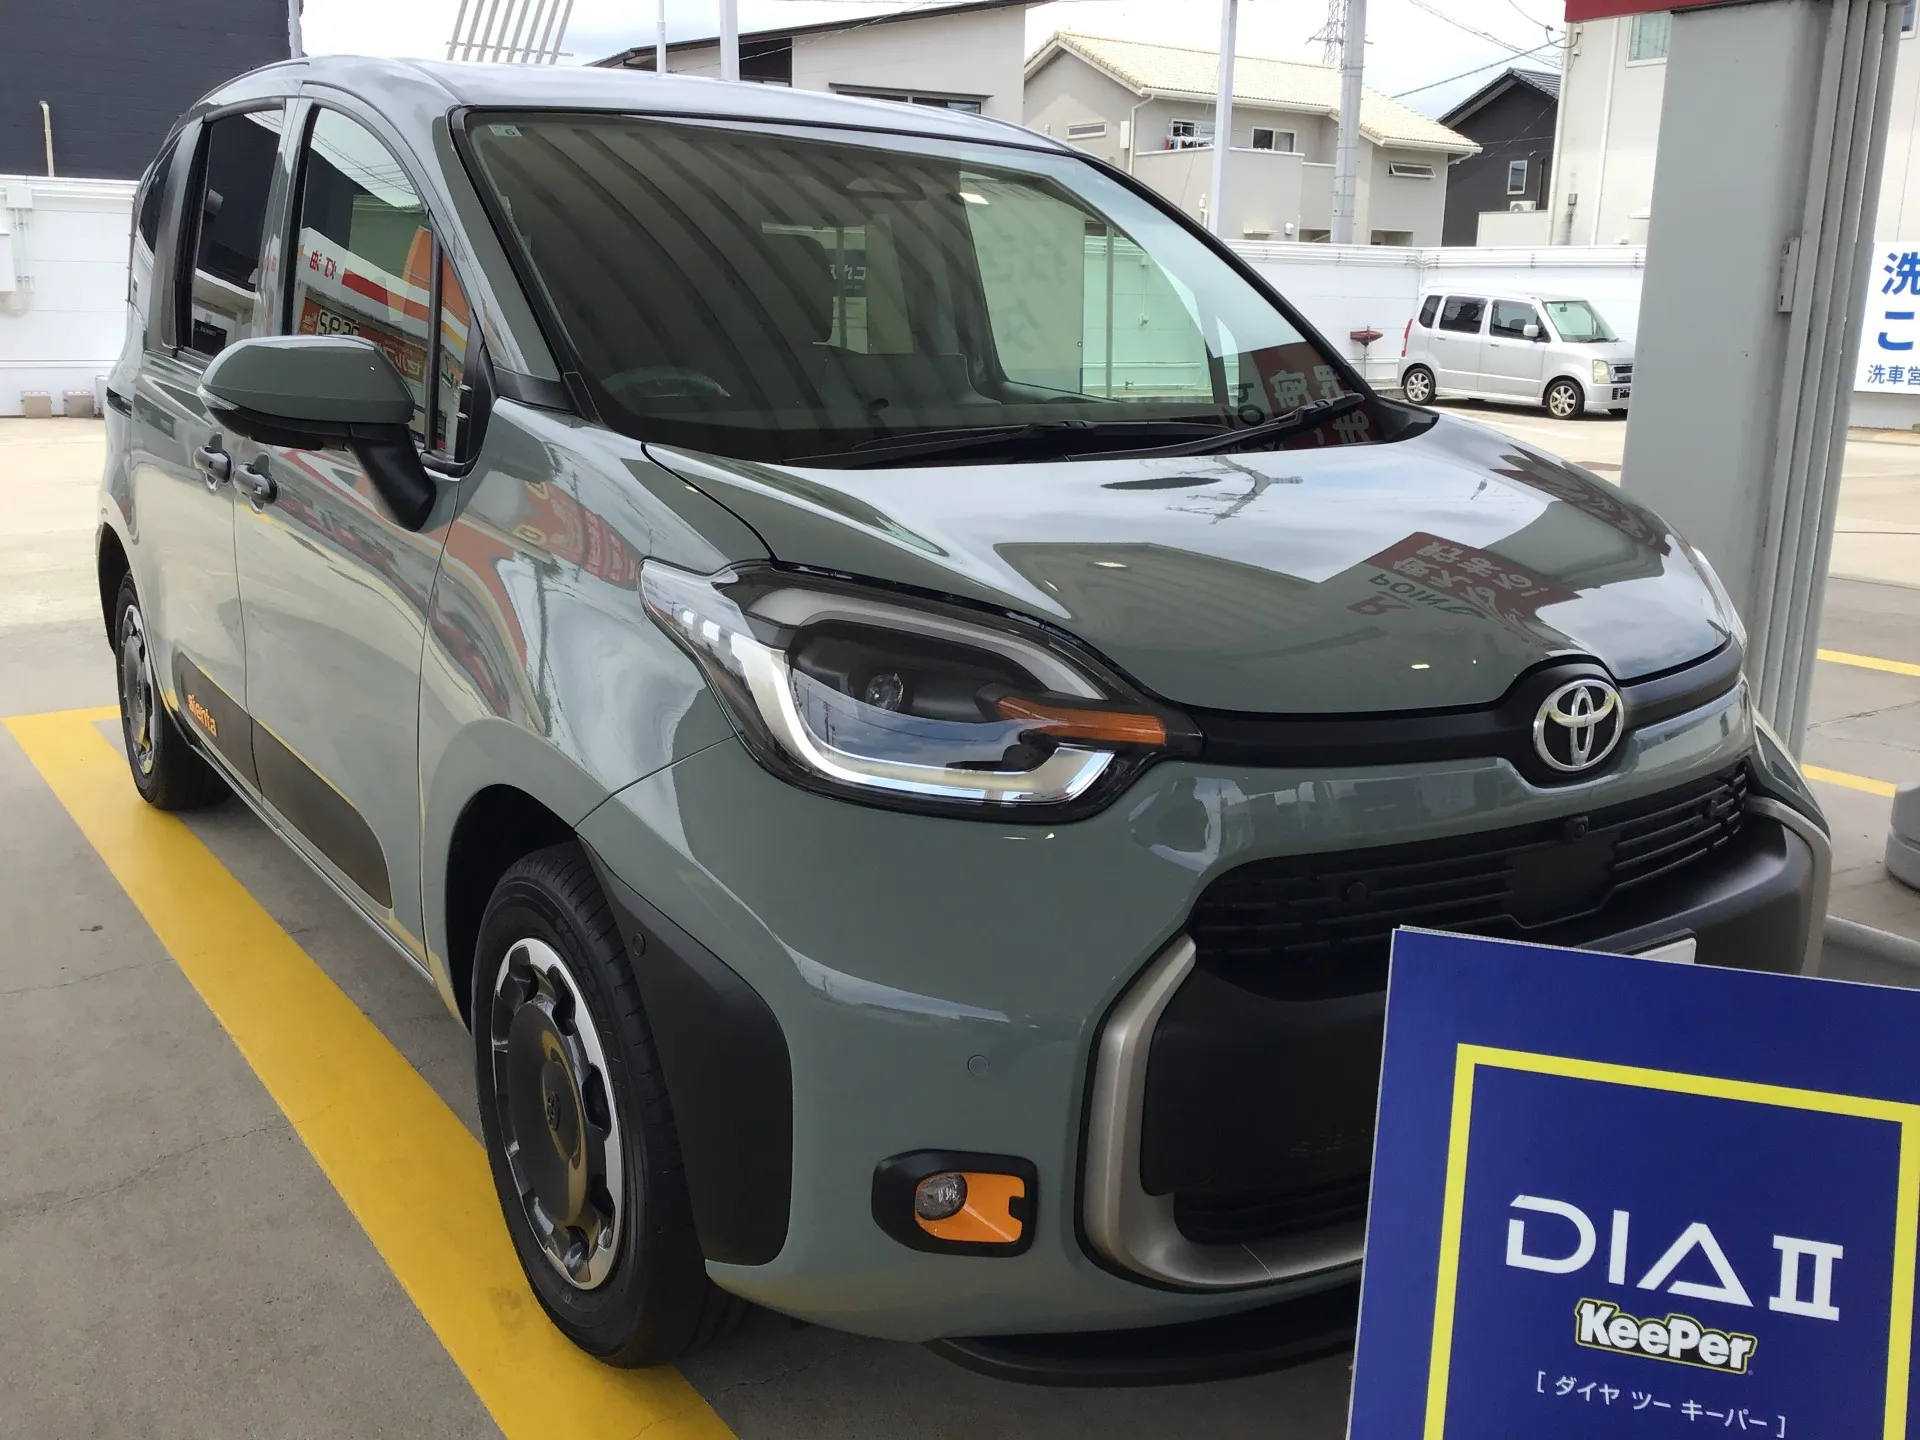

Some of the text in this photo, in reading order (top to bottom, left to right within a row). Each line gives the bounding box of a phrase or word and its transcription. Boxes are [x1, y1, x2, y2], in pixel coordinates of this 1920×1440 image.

[1881, 251, 1920, 295] 洗
[1878, 311, 1915, 351] こ
[1867, 364, 1920, 386] 洗車営
[187, 694, 218, 738] sienta
[1506, 1194, 1754, 1307] DIA
[1578, 1300, 1754, 1370] KeePer
[1631, 1391, 1672, 1411] ツー
[1681, 1398, 1768, 1431] キーパー
